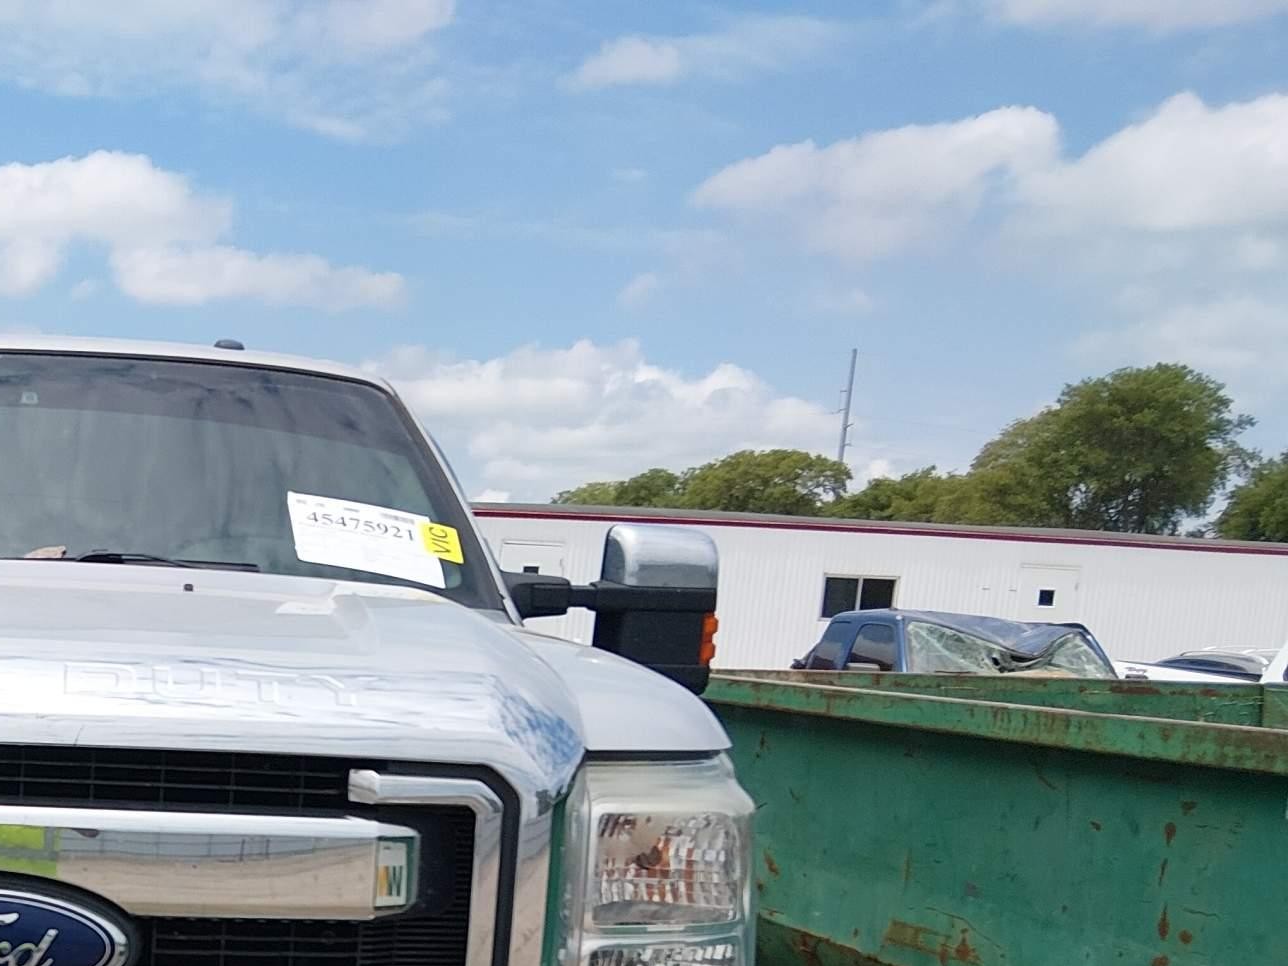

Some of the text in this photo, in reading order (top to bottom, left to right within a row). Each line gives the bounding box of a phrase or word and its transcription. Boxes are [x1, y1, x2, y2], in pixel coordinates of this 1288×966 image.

[306, 512, 415, 541] 45475921
[429, 526, 451, 554] VIC
[63, 661, 379, 706] DUTY
